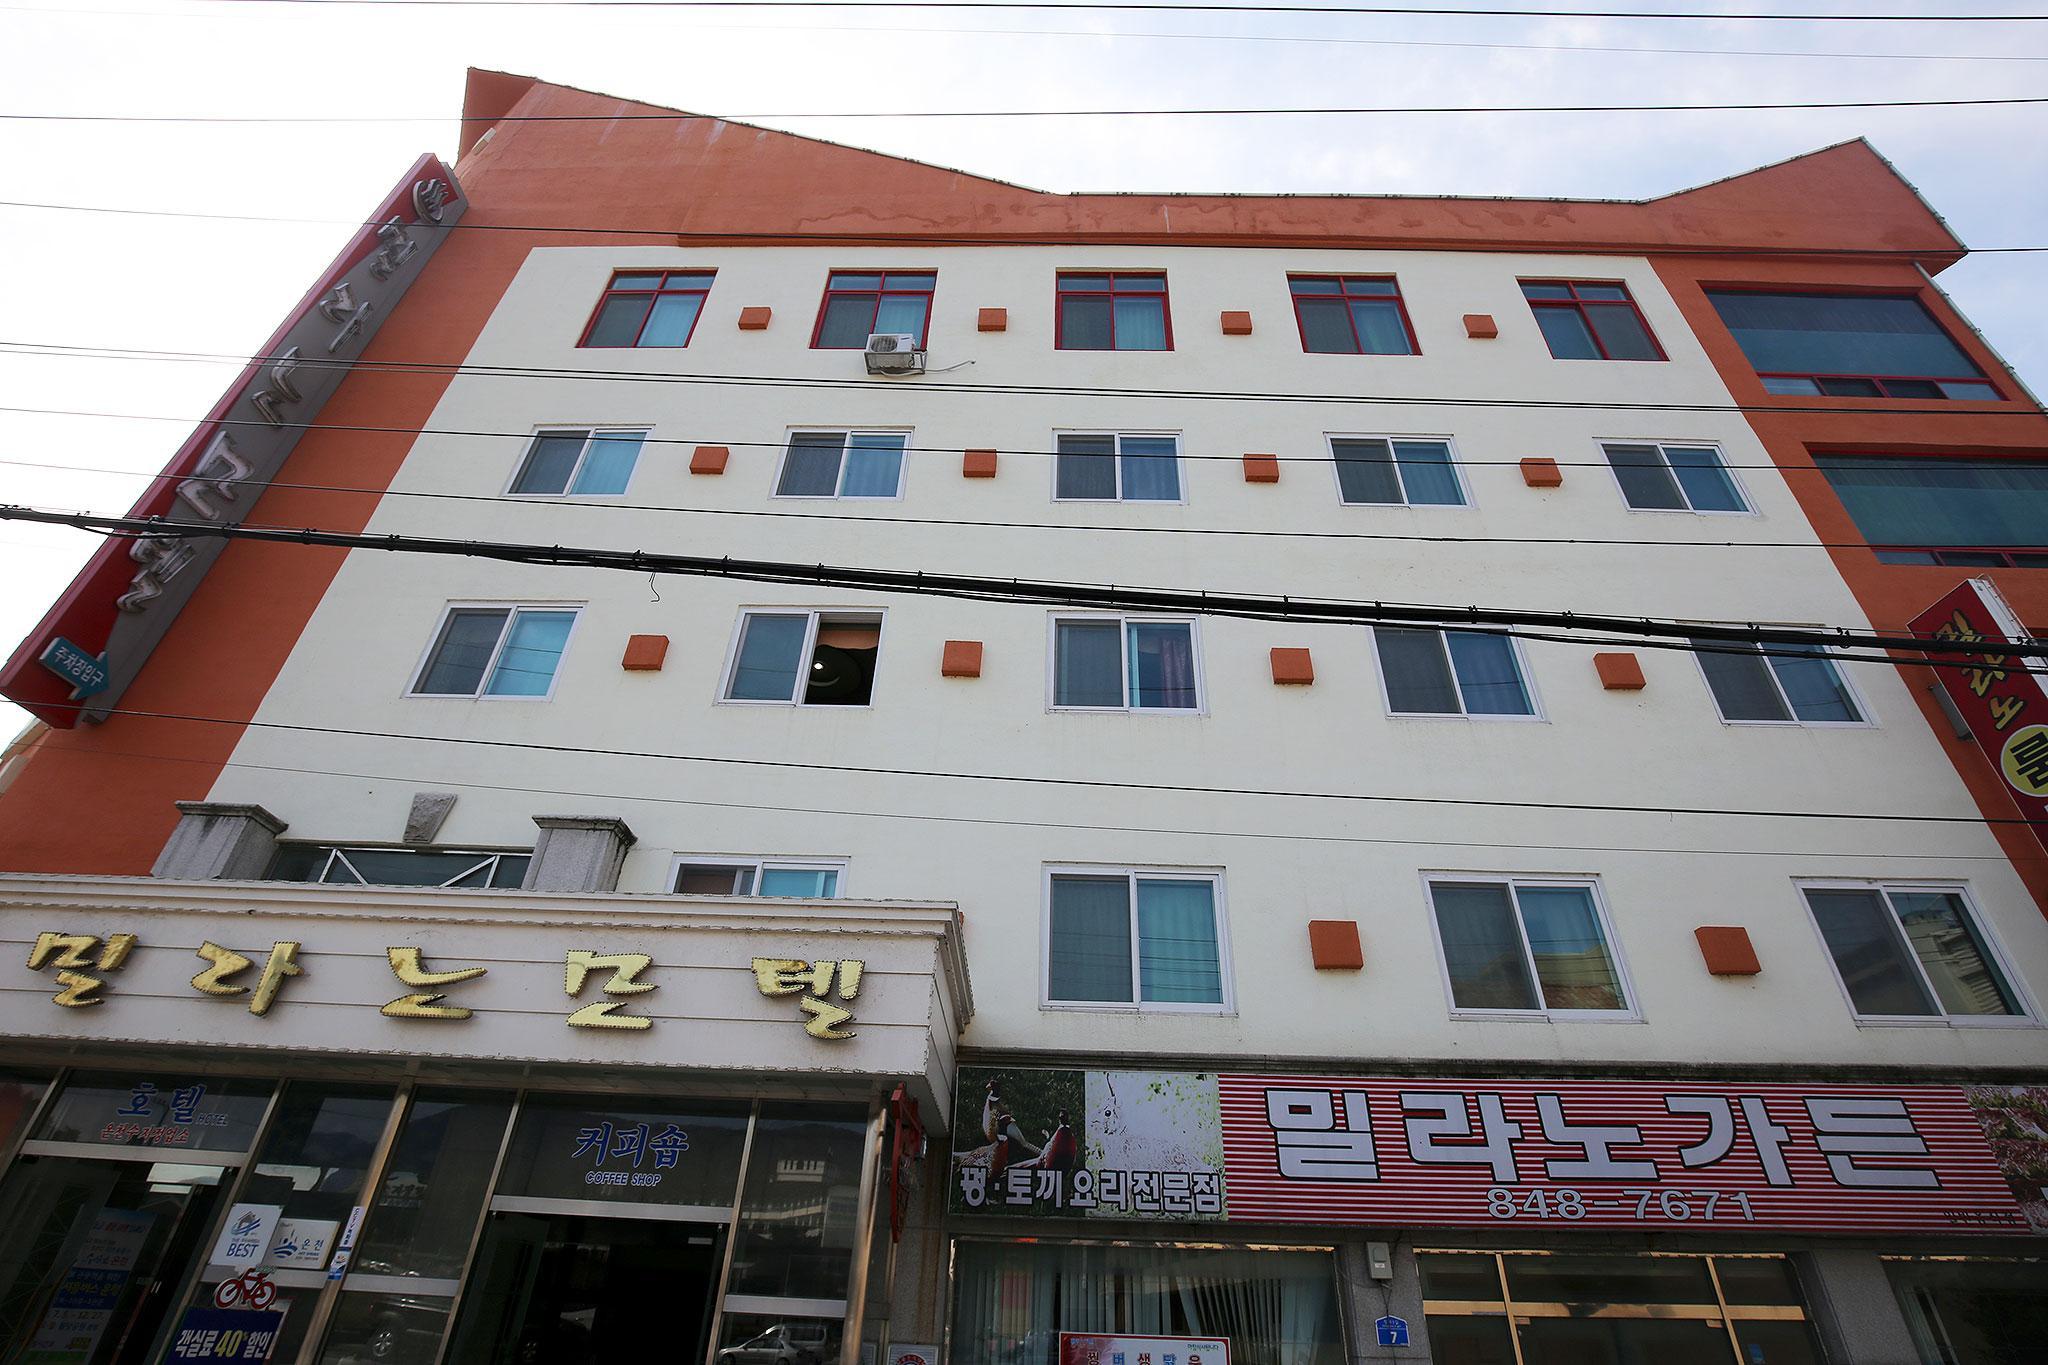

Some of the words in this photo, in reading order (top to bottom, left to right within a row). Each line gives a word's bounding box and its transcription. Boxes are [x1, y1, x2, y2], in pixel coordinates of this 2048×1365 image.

[54, 645, 106, 688] 주차장입구
[195, 1112, 229, 1126] HOTEL
[571, 1121, 689, 1169] 커피숍
[1265, 1087, 1943, 1191] 밀라노가든
[585, 1171, 629, 1186] COFFEE
[630, 1173, 662, 1187] SHOP
[1069, 1169, 1222, 1214] 요리전문점
[1486, 1187, 1755, 1222] 848-7671
[226, 1243, 259, 1257] BEST
[174, 1328, 220, 1358] 객실료
[243, 1331, 273, 1359] 할인
[1389, 1331, 1398, 1344] 7
